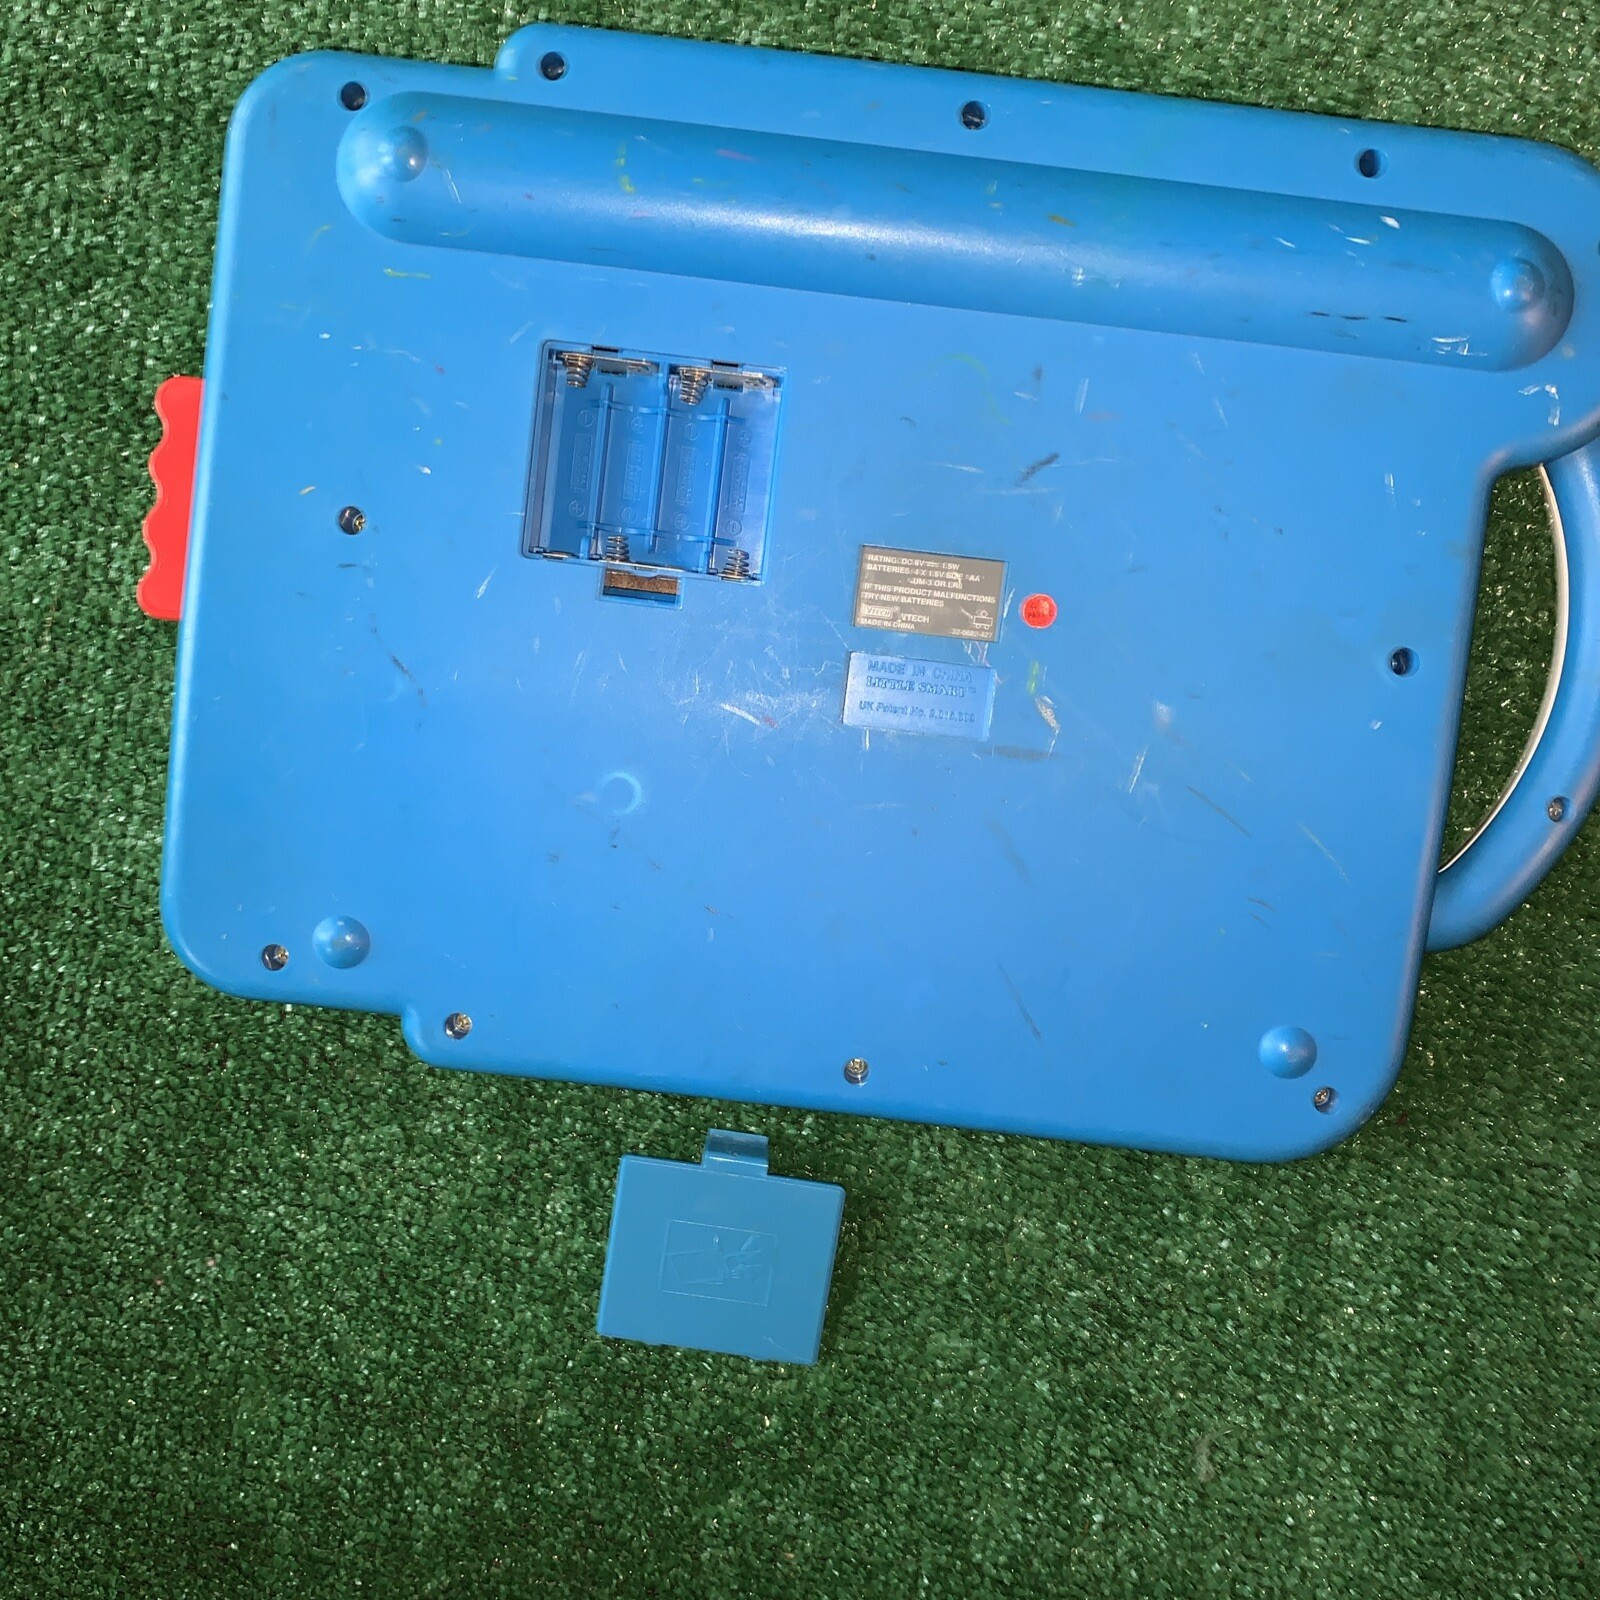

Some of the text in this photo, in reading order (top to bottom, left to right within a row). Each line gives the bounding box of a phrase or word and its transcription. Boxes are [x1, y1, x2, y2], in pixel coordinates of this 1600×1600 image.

[902, 558, 913, 566] DC
[942, 562, 960, 570] 1.5W
[929, 570, 944, 578] 1.5V
[946, 571, 963, 580] SIZE
[864, 592, 945, 608] TRY NEW BATTERIES
[874, 584, 892, 592] THIS
[893, 586, 932, 597] PRODUCT
[934, 590, 996, 604] MALFUNCTIONS
[861, 618, 916, 630] MADE IN CHINA
[901, 613, 930, 624] VTECH
[868, 660, 973, 683] MADE IN CHINA
[866, 675, 915, 691] LITTLE
[859, 700, 874, 711] UK
[876, 702, 908, 716] Patent
